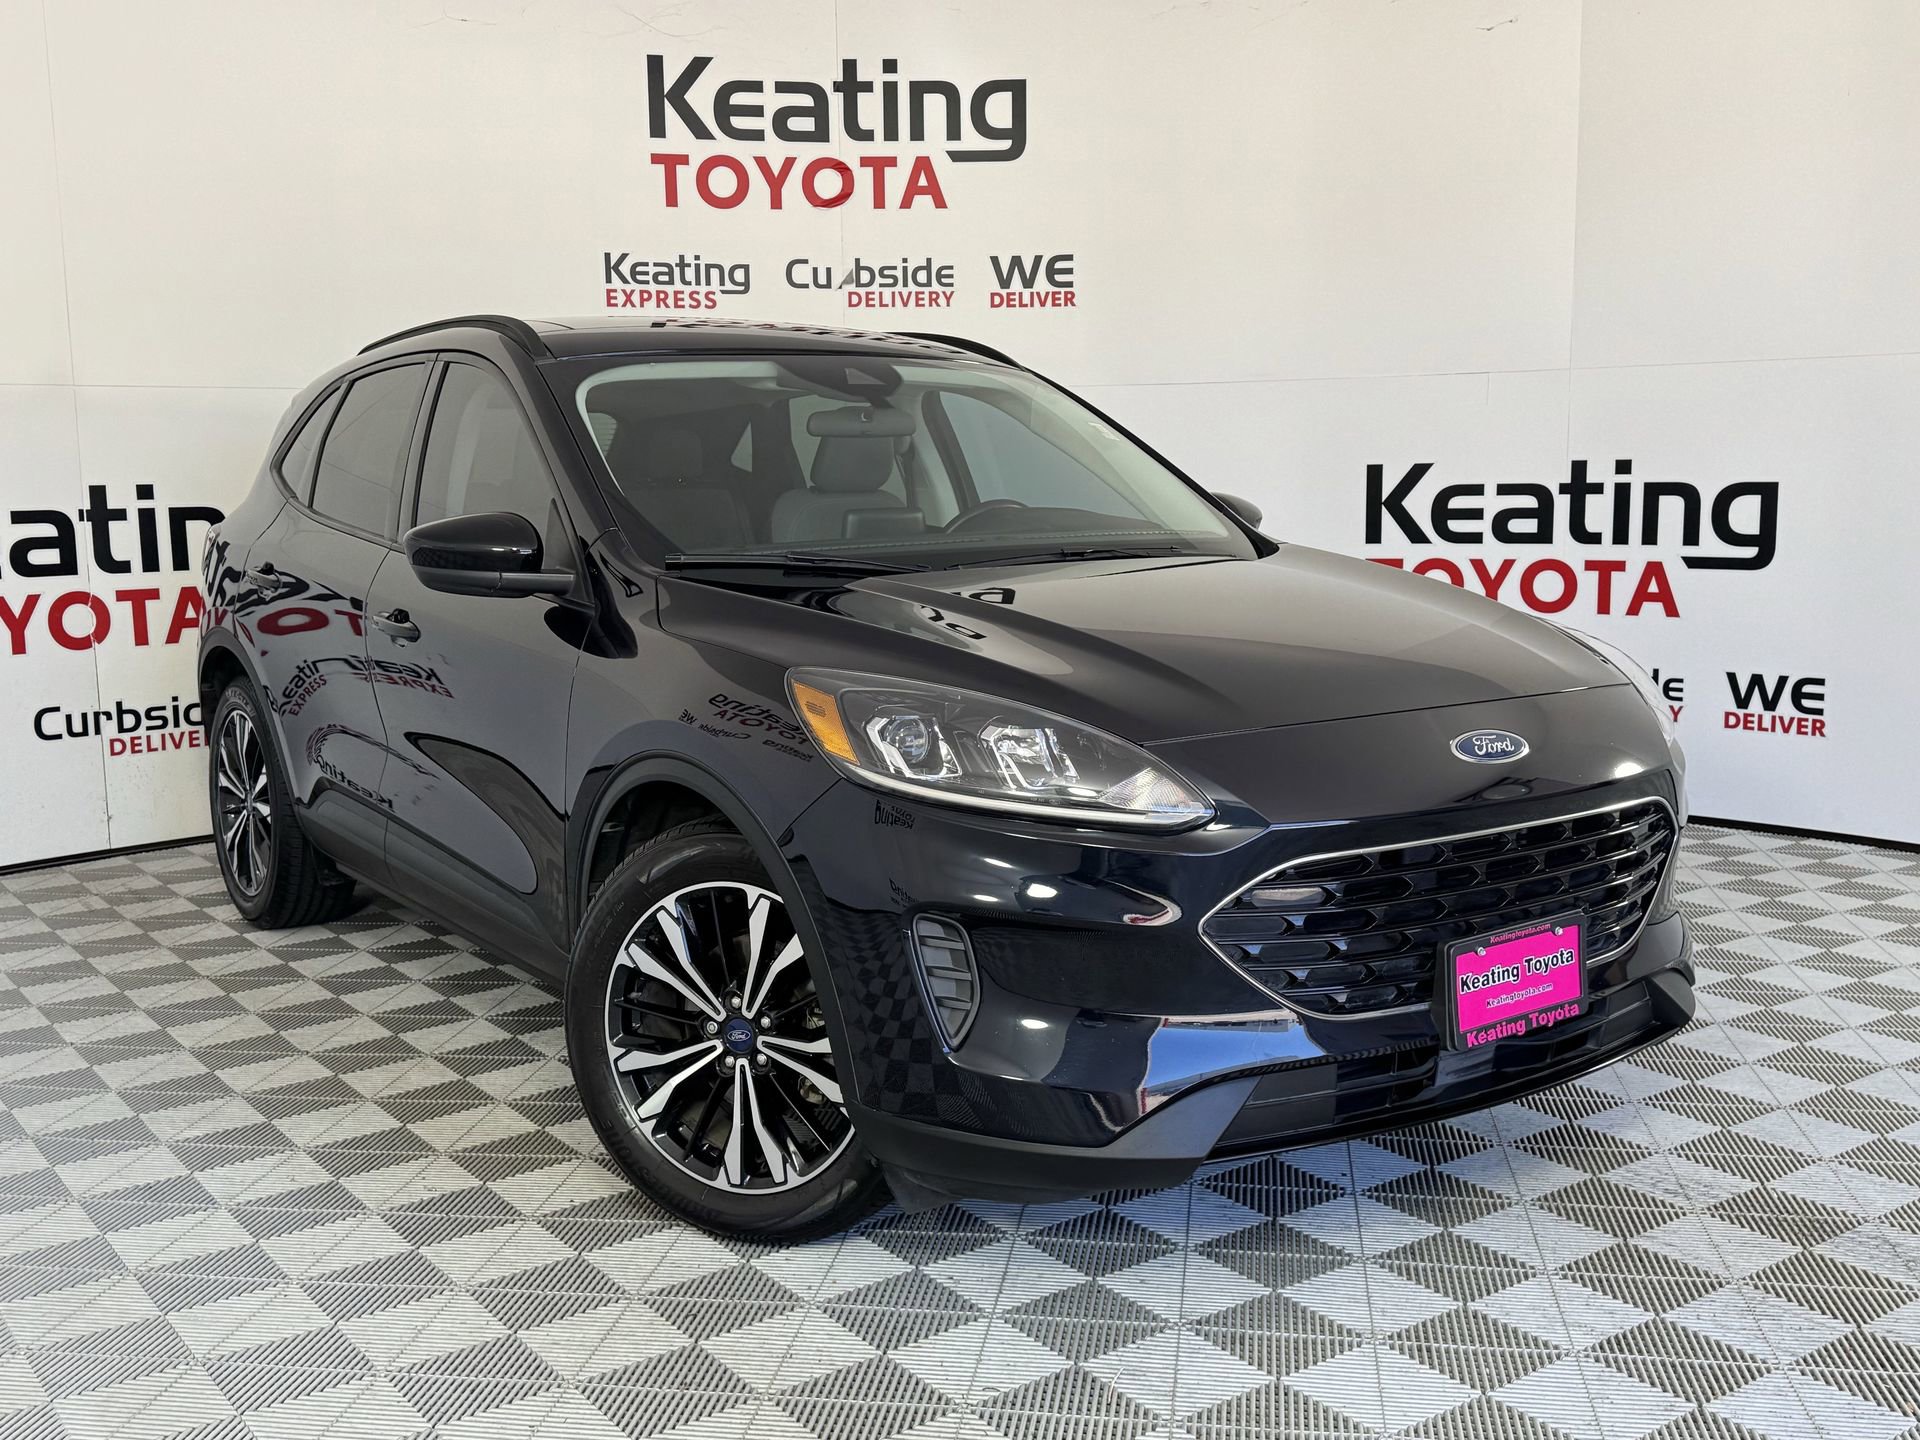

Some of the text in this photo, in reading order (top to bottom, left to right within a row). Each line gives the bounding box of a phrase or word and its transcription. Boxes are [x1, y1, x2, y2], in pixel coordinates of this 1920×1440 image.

[646, 54, 1027, 162] Keating
[650, 153, 948, 210] TOYOTA
[604, 252, 751, 295] Keating
[785, 257, 955, 290] Cubside
[990, 253, 1075, 290] WE
[606, 288, 718, 310] EXPRESS
[847, 290, 956, 309] DELIVERY
[990, 290, 1076, 309] DELIVER
[0, 484, 226, 578] atin
[1365, 459, 1779, 571] Keating
[1725, 671, 1826, 716] WE
[109, 729, 210, 757] DELIVE
[1723, 711, 1827, 738] DELIVER
[1471, 734, 1516, 757] Ford
[1460, 948, 1575, 995] Keating Toyota
[1467, 1003, 1580, 1048] Keating Toyota
